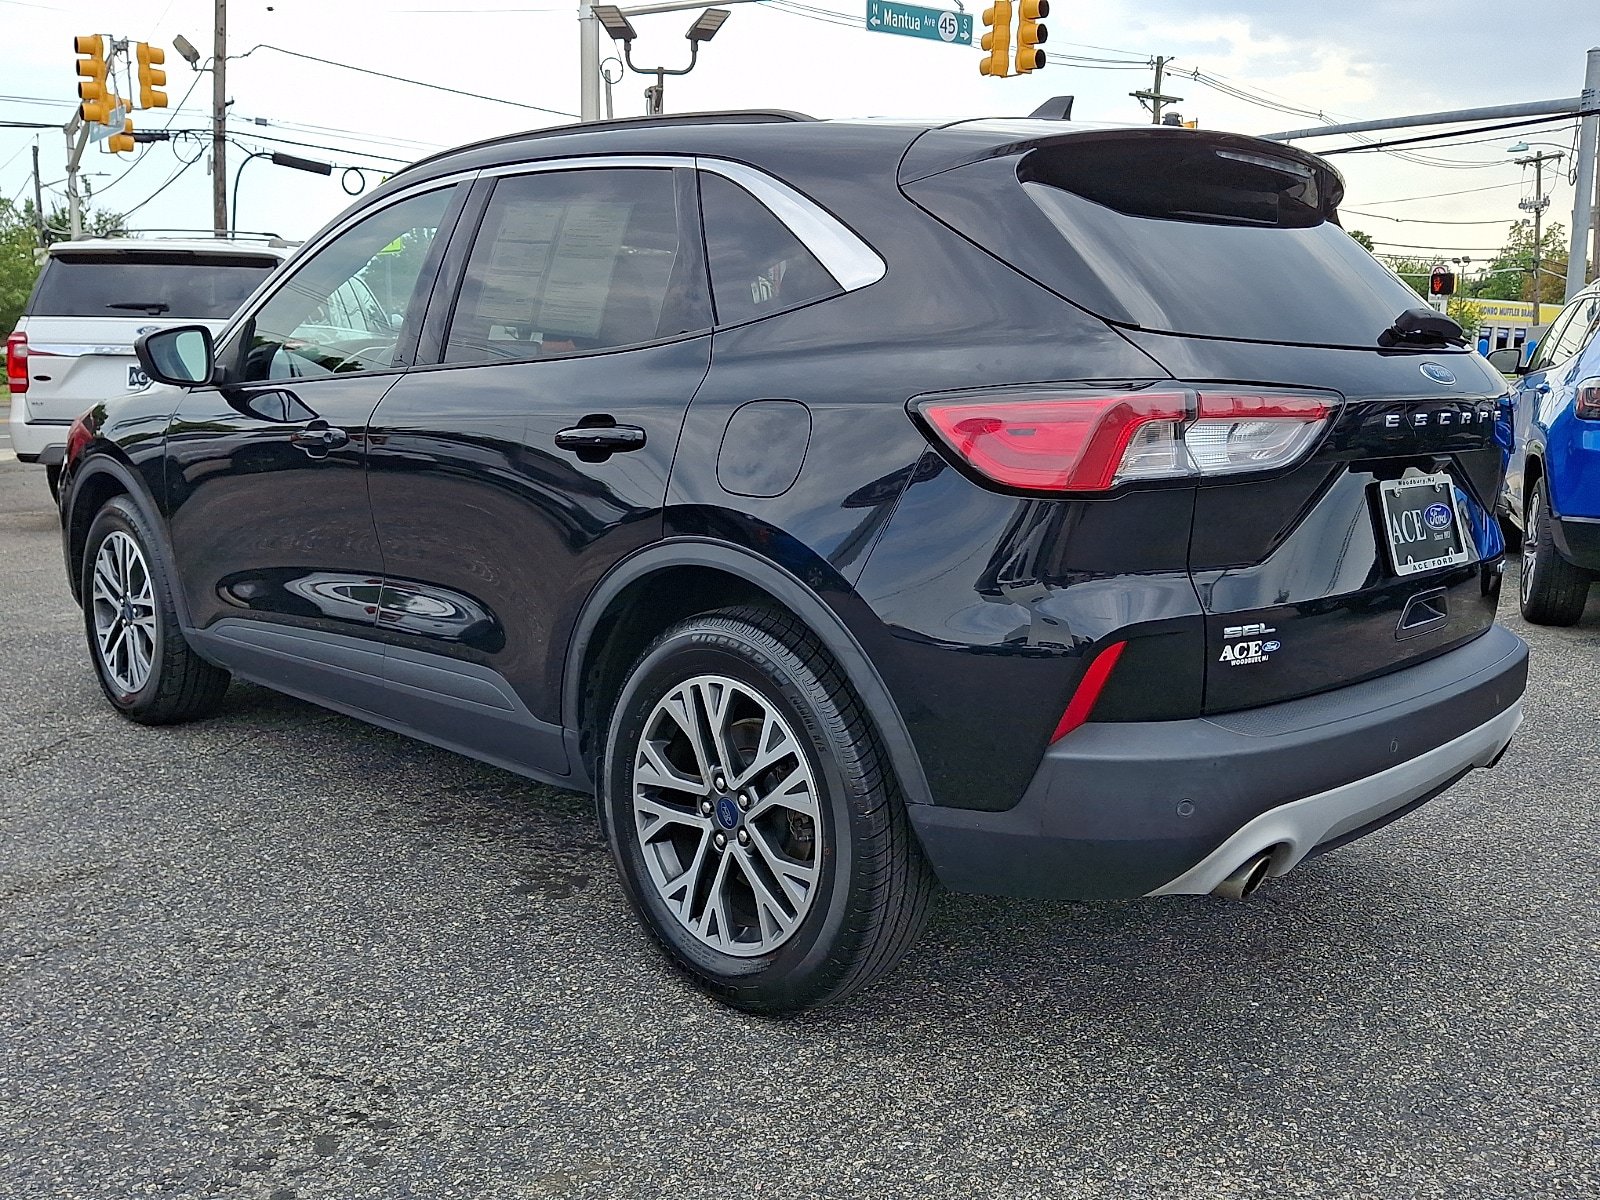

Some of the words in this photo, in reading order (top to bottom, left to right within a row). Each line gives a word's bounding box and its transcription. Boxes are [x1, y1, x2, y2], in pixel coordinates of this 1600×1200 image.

[872, 3, 878, 14] N
[883, 8, 920, 31] Mantua
[924, 15, 936, 27] Ave
[940, 17, 956, 34] 45
[963, 18, 968, 29] S
[1499, 307, 1520, 316] MUFFLER
[1385, 411, 1501, 428] ESCAPE
[1392, 510, 1427, 544] ACE
[1412, 562, 1428, 571] ACE
[1432, 557, 1453, 567] FORD
[1224, 622, 1276, 639] SEL
[1219, 640, 1262, 661] ACE
